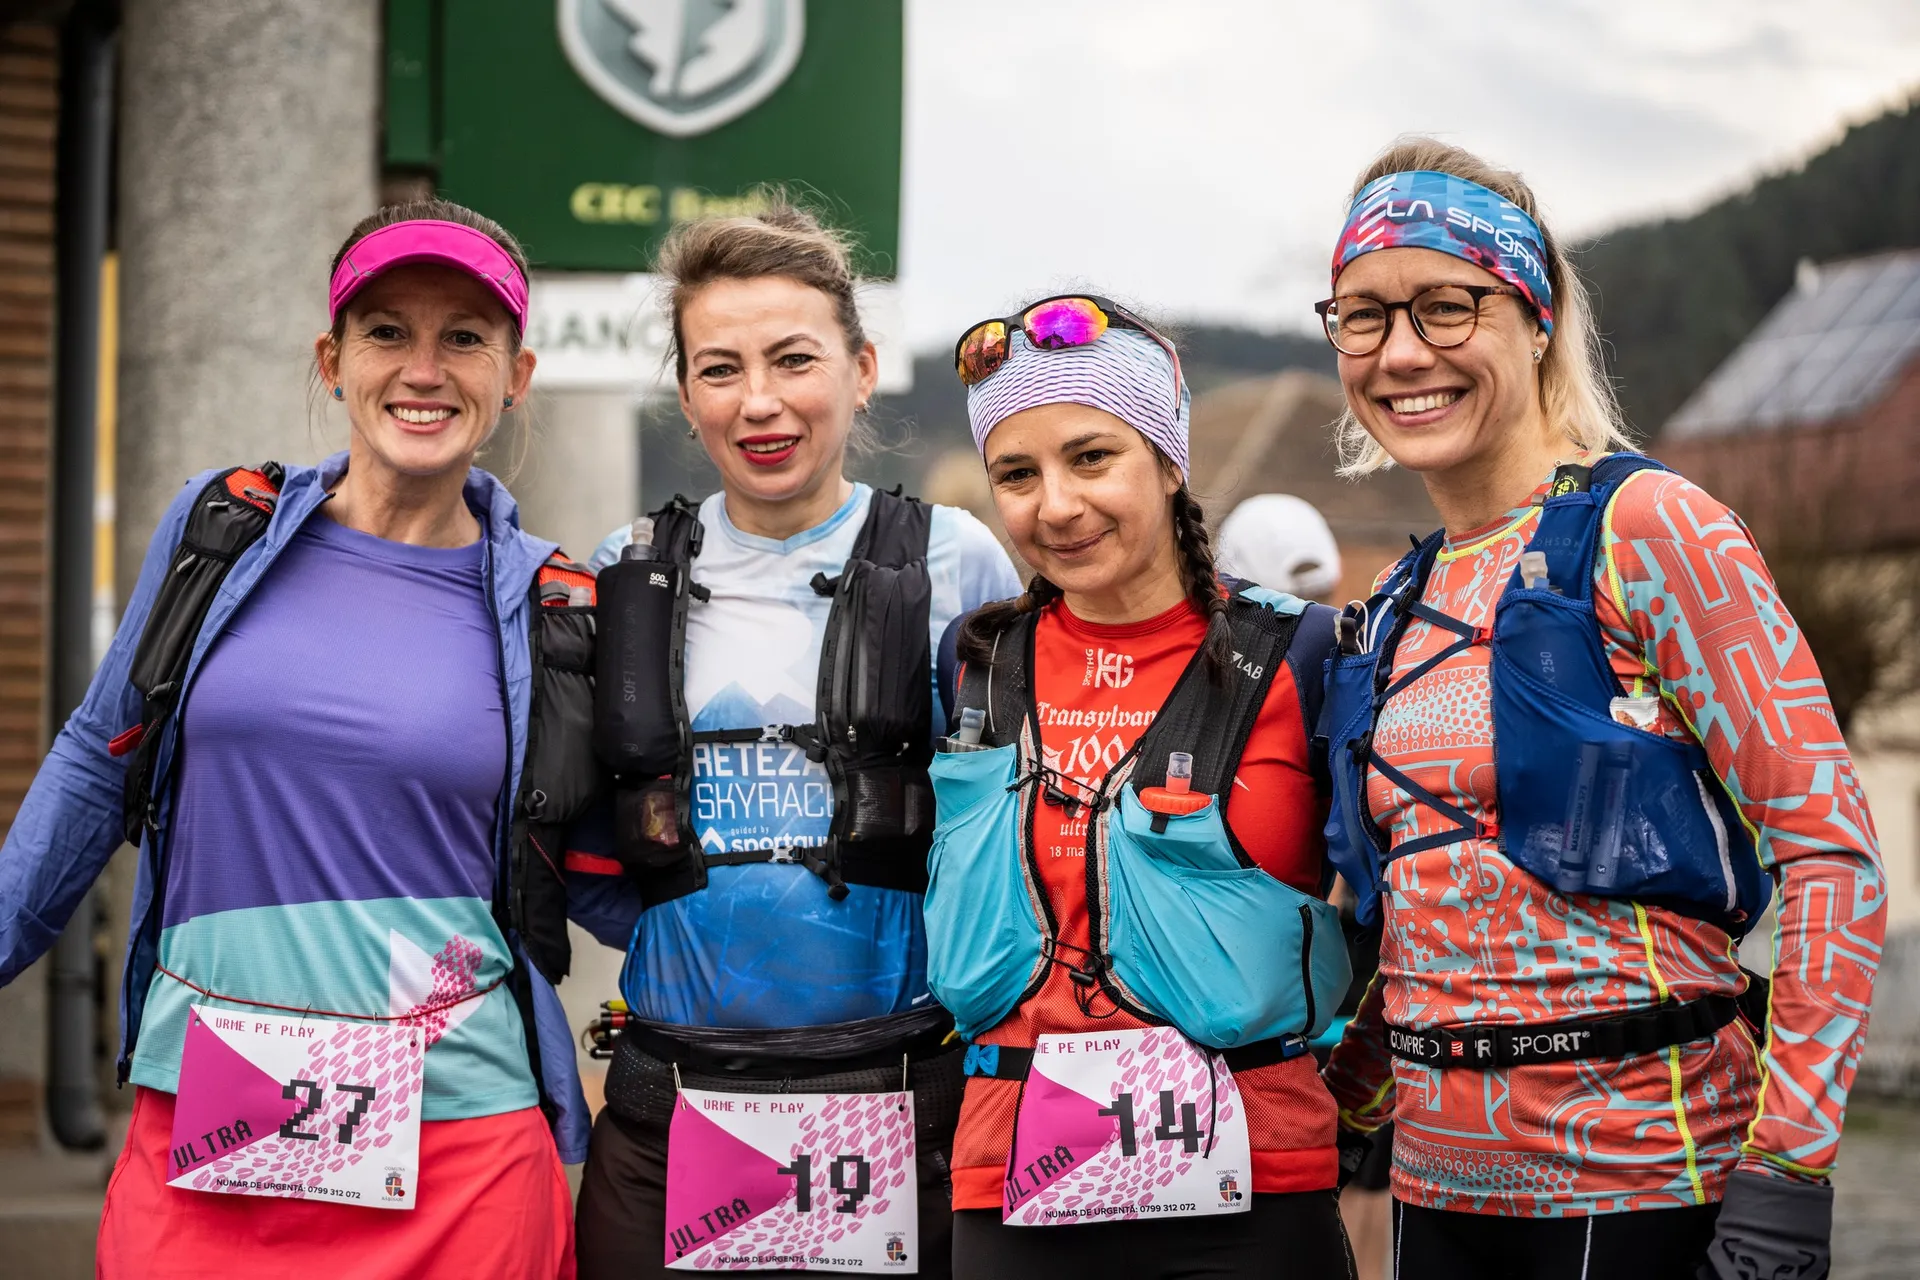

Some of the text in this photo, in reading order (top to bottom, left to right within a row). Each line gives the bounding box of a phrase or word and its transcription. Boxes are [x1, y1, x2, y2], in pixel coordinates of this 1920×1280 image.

[1387, 200, 1434, 218] LA
[731, 825, 769, 835] guided by
[1050, 846, 1062, 857] 18
[215, 1017, 315, 1038] URME PE PLAY
[1058, 1042, 1076, 1054] PE
[1085, 1038, 1121, 1052] PLAY
[279, 1079, 376, 1144] 27
[703, 1099, 805, 1113] URME PE PLAY
[1098, 1090, 1205, 1157] 14
[173, 1119, 253, 1169] ULTRA
[777, 1154, 871, 1214] 19
[1005, 1145, 1076, 1207] ULTRA
[250, 1181, 262, 1189] DE
[307, 1186, 329, 1195] 0799
[330, 1189, 344, 1197] 312
[345, 1190, 361, 1199] 072
[1080, 1208, 1092, 1216] DE
[1139, 1205, 1161, 1213] 0799
[1163, 1204, 1178, 1212] 312
[1179, 1203, 1196, 1211] 072
[669, 1198, 751, 1251] ULTRA
[809, 1257, 830, 1265] 0799
[832, 1258, 846, 1266] 312
